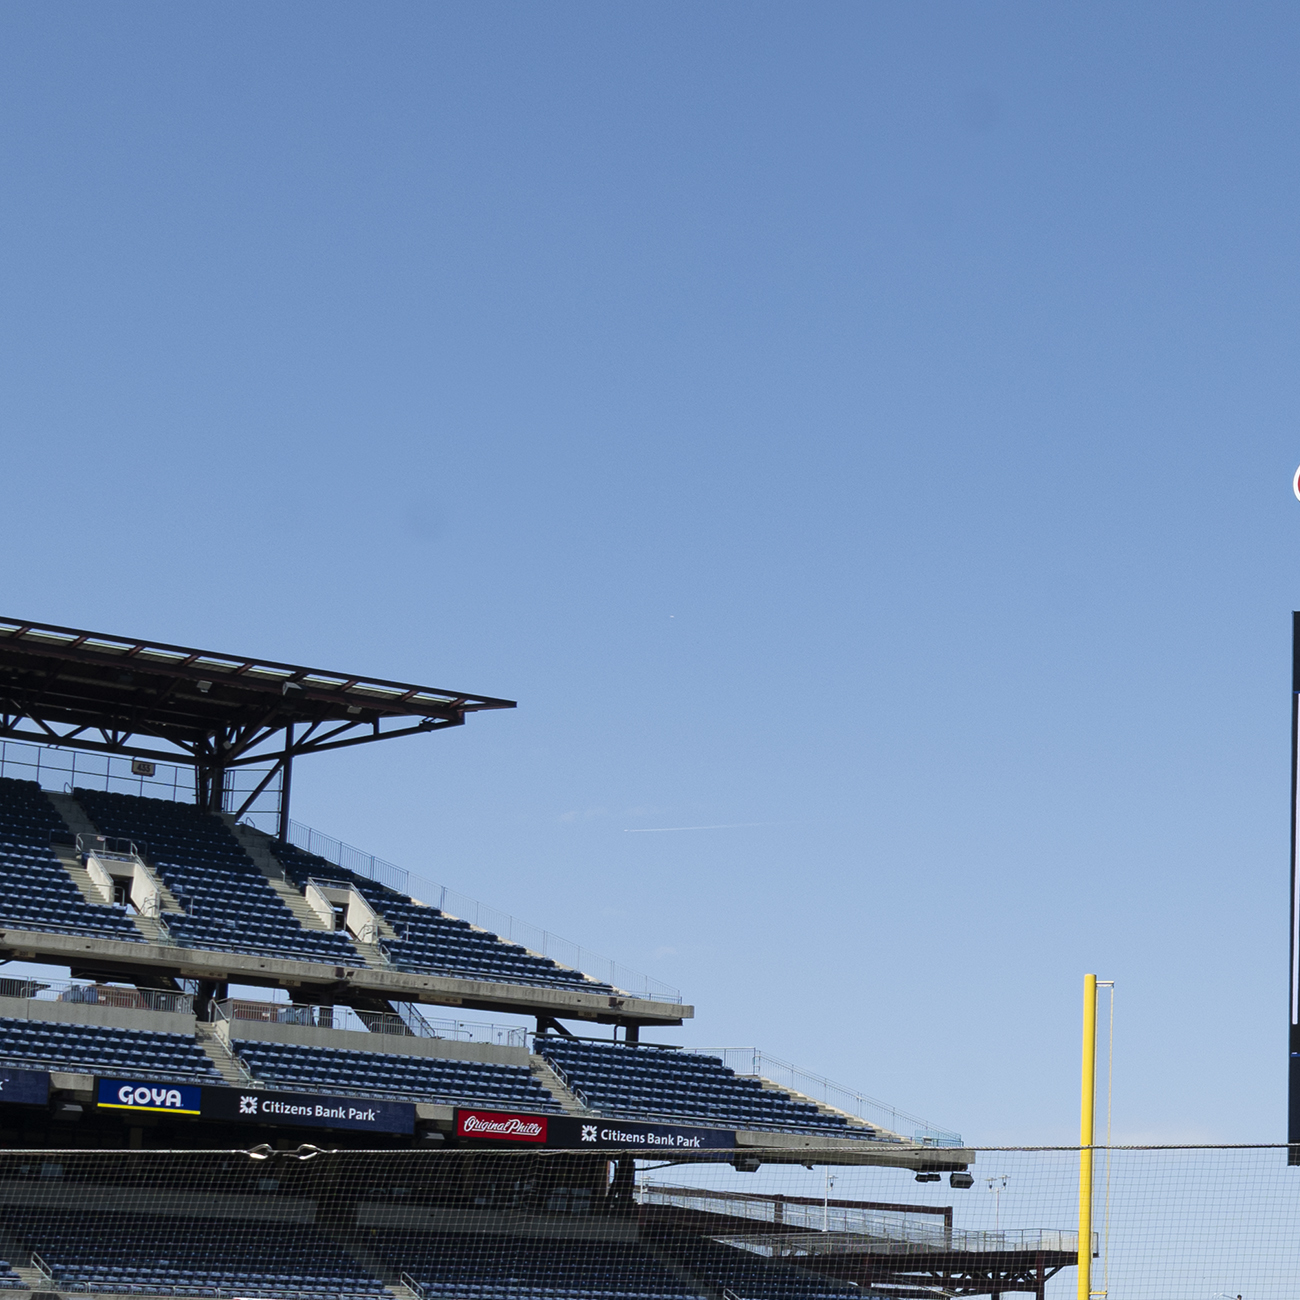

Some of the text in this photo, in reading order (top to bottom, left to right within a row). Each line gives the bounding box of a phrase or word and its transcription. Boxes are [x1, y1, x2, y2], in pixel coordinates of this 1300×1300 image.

[118, 1085, 182, 1107] GOYA
[262, 1100, 376, 1121] Citizens Bank Park
[463, 1115, 542, 1136] Original Philly
[601, 1129, 700, 1148] Citizens Bank Park
